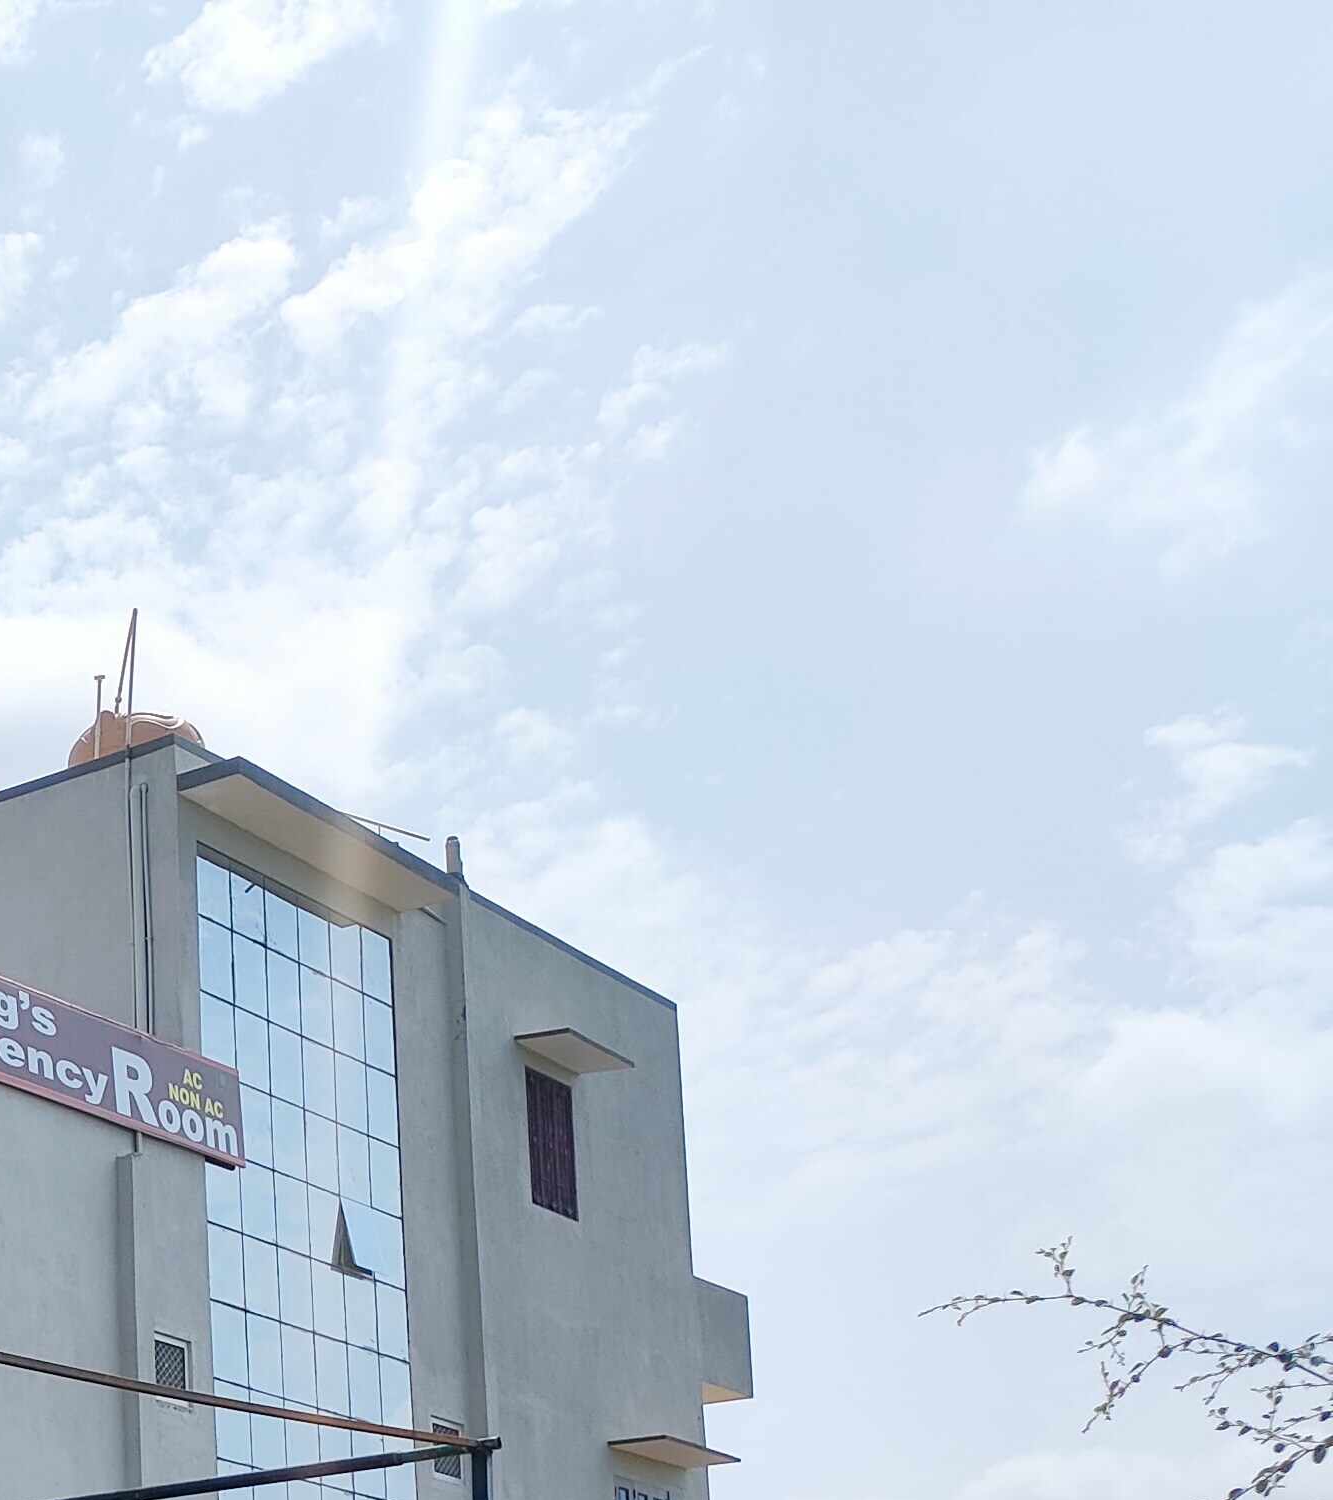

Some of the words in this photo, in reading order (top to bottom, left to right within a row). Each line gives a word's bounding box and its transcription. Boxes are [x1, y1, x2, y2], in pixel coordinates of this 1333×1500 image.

[183, 1068, 203, 1090] AC
[111, 1046, 239, 1158] Room
[168, 1082, 201, 1111] NON
[204, 1097, 224, 1119] AC
